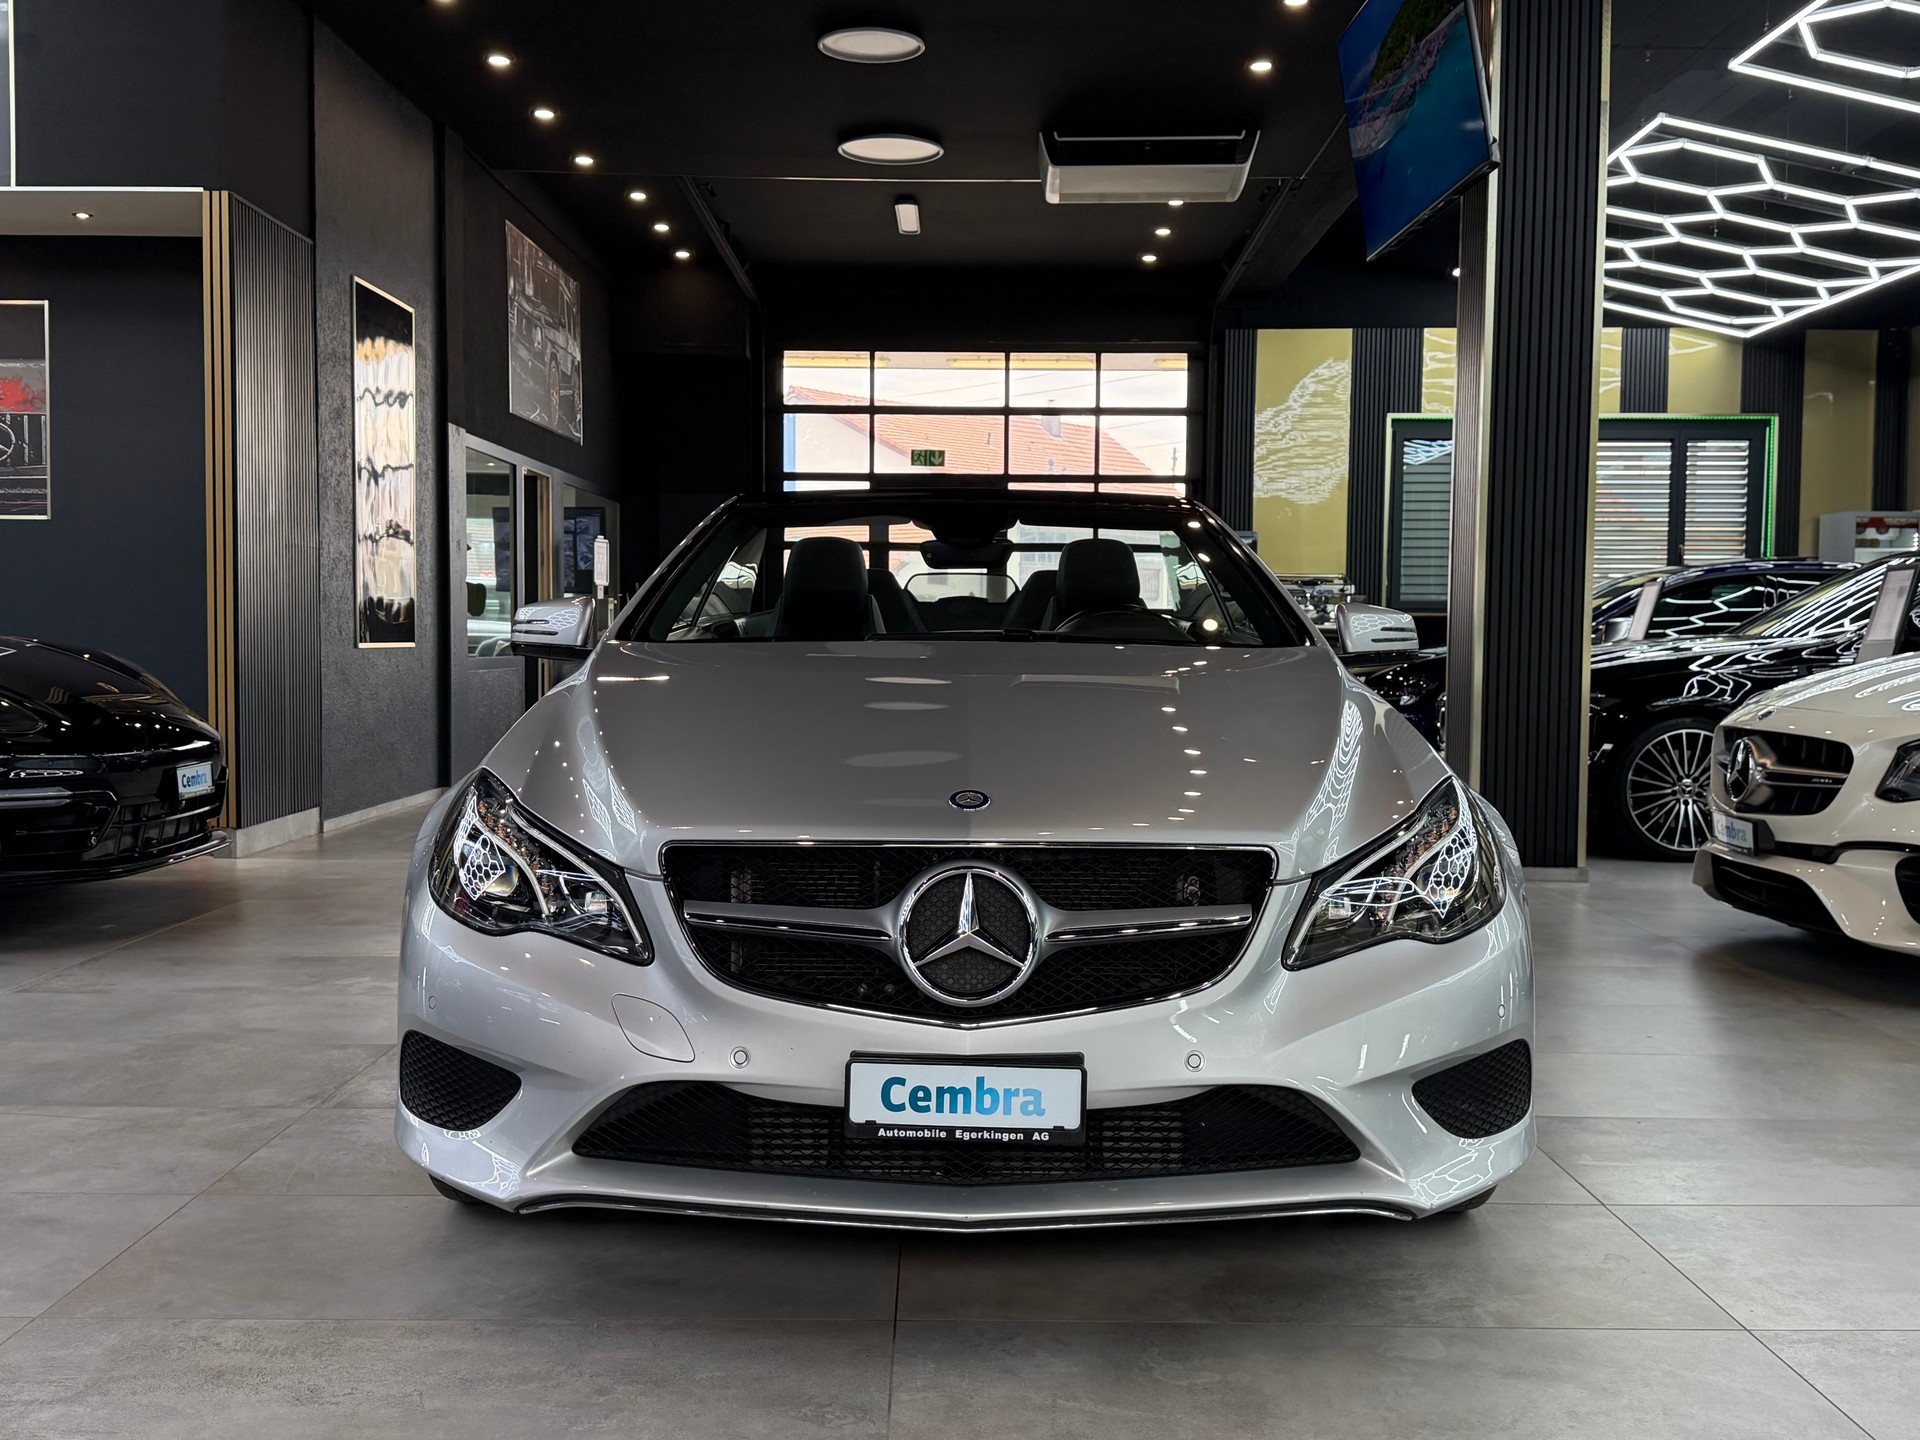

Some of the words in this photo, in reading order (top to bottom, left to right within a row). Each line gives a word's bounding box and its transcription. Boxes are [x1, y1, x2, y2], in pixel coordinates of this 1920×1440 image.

[181, 770, 208, 788] Cembra
[880, 1076, 1046, 1117] Cembra
[877, 1128, 947, 1138] Automobile
[955, 1129, 1024, 1141] Egerkingen
[1032, 1131, 1050, 1141] AG
